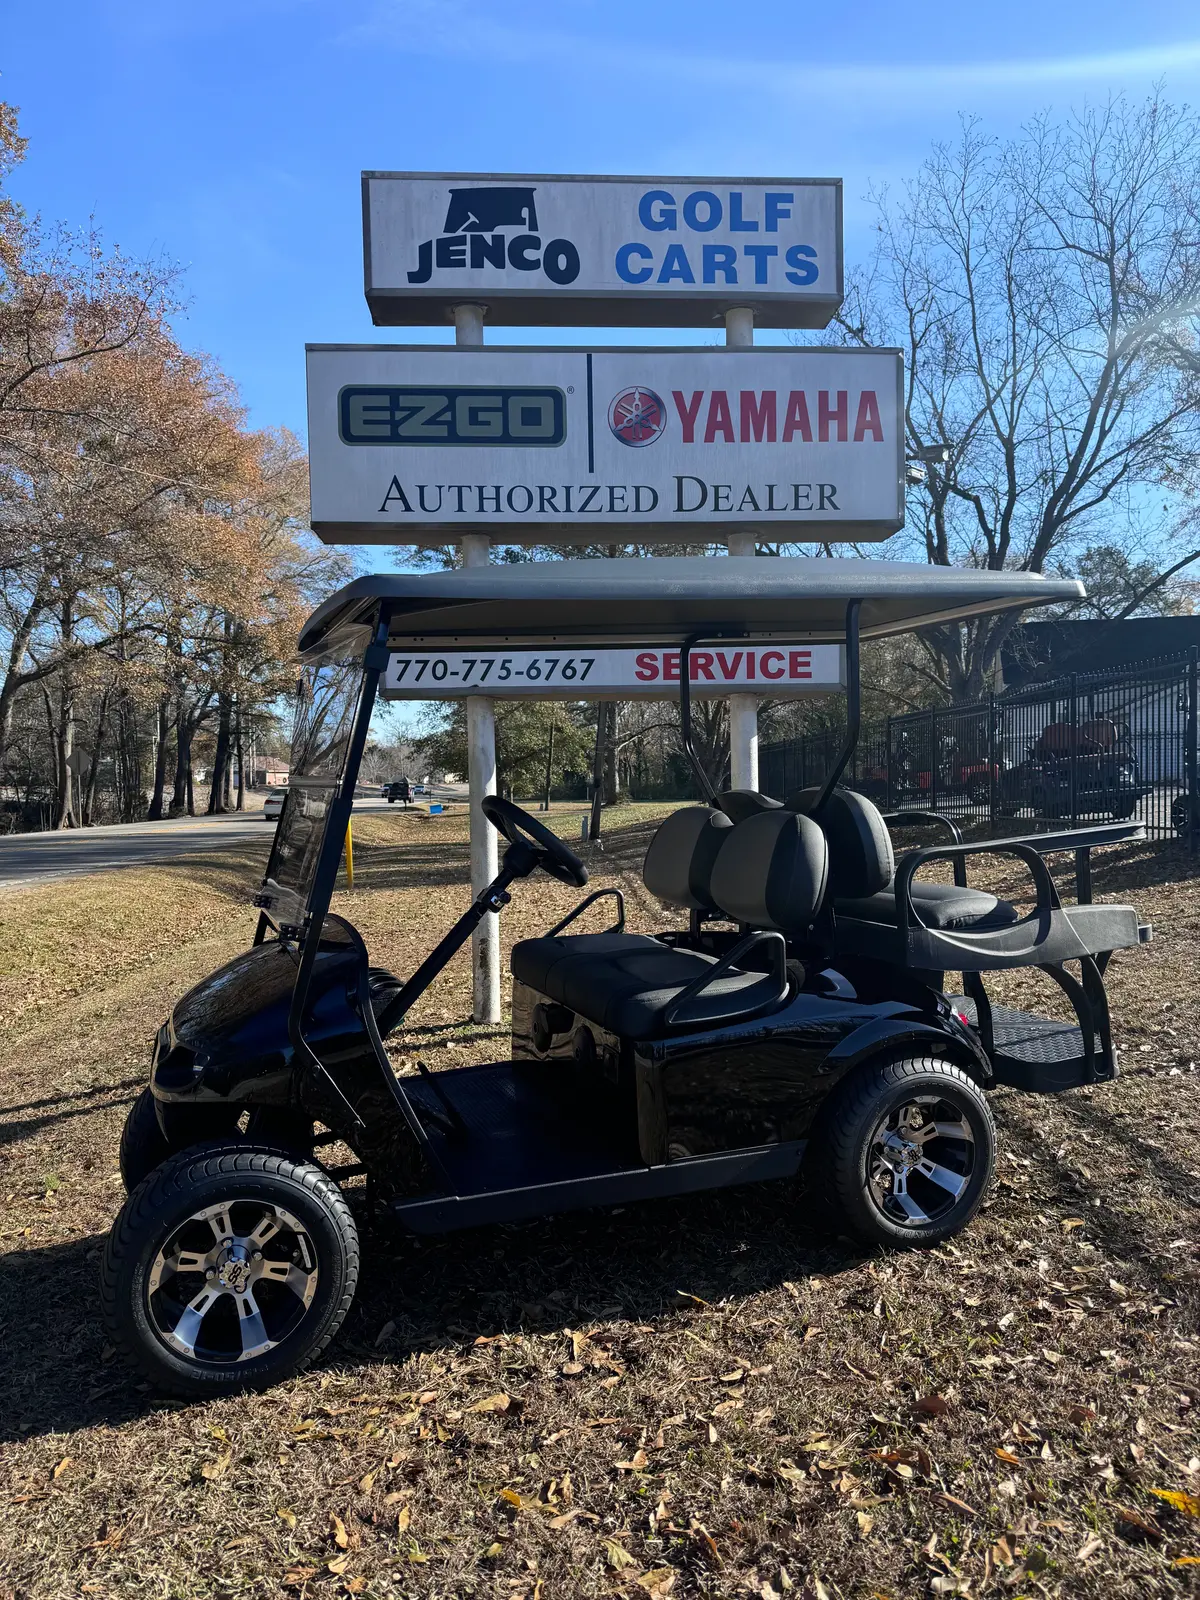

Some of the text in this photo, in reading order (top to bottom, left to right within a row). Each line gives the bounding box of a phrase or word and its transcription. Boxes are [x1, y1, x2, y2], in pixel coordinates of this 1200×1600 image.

[638, 190, 795, 232] GOLF
[407, 234, 580, 285] JENCO
[615, 242, 819, 285] CARTS
[349, 395, 555, 437] EZGO
[671, 390, 884, 443] YAMAHA
[377, 475, 841, 513] AUTHORIZED DEALER
[396, 658, 596, 682] 770-775-6767
[634, 651, 812, 681] SERVICE
